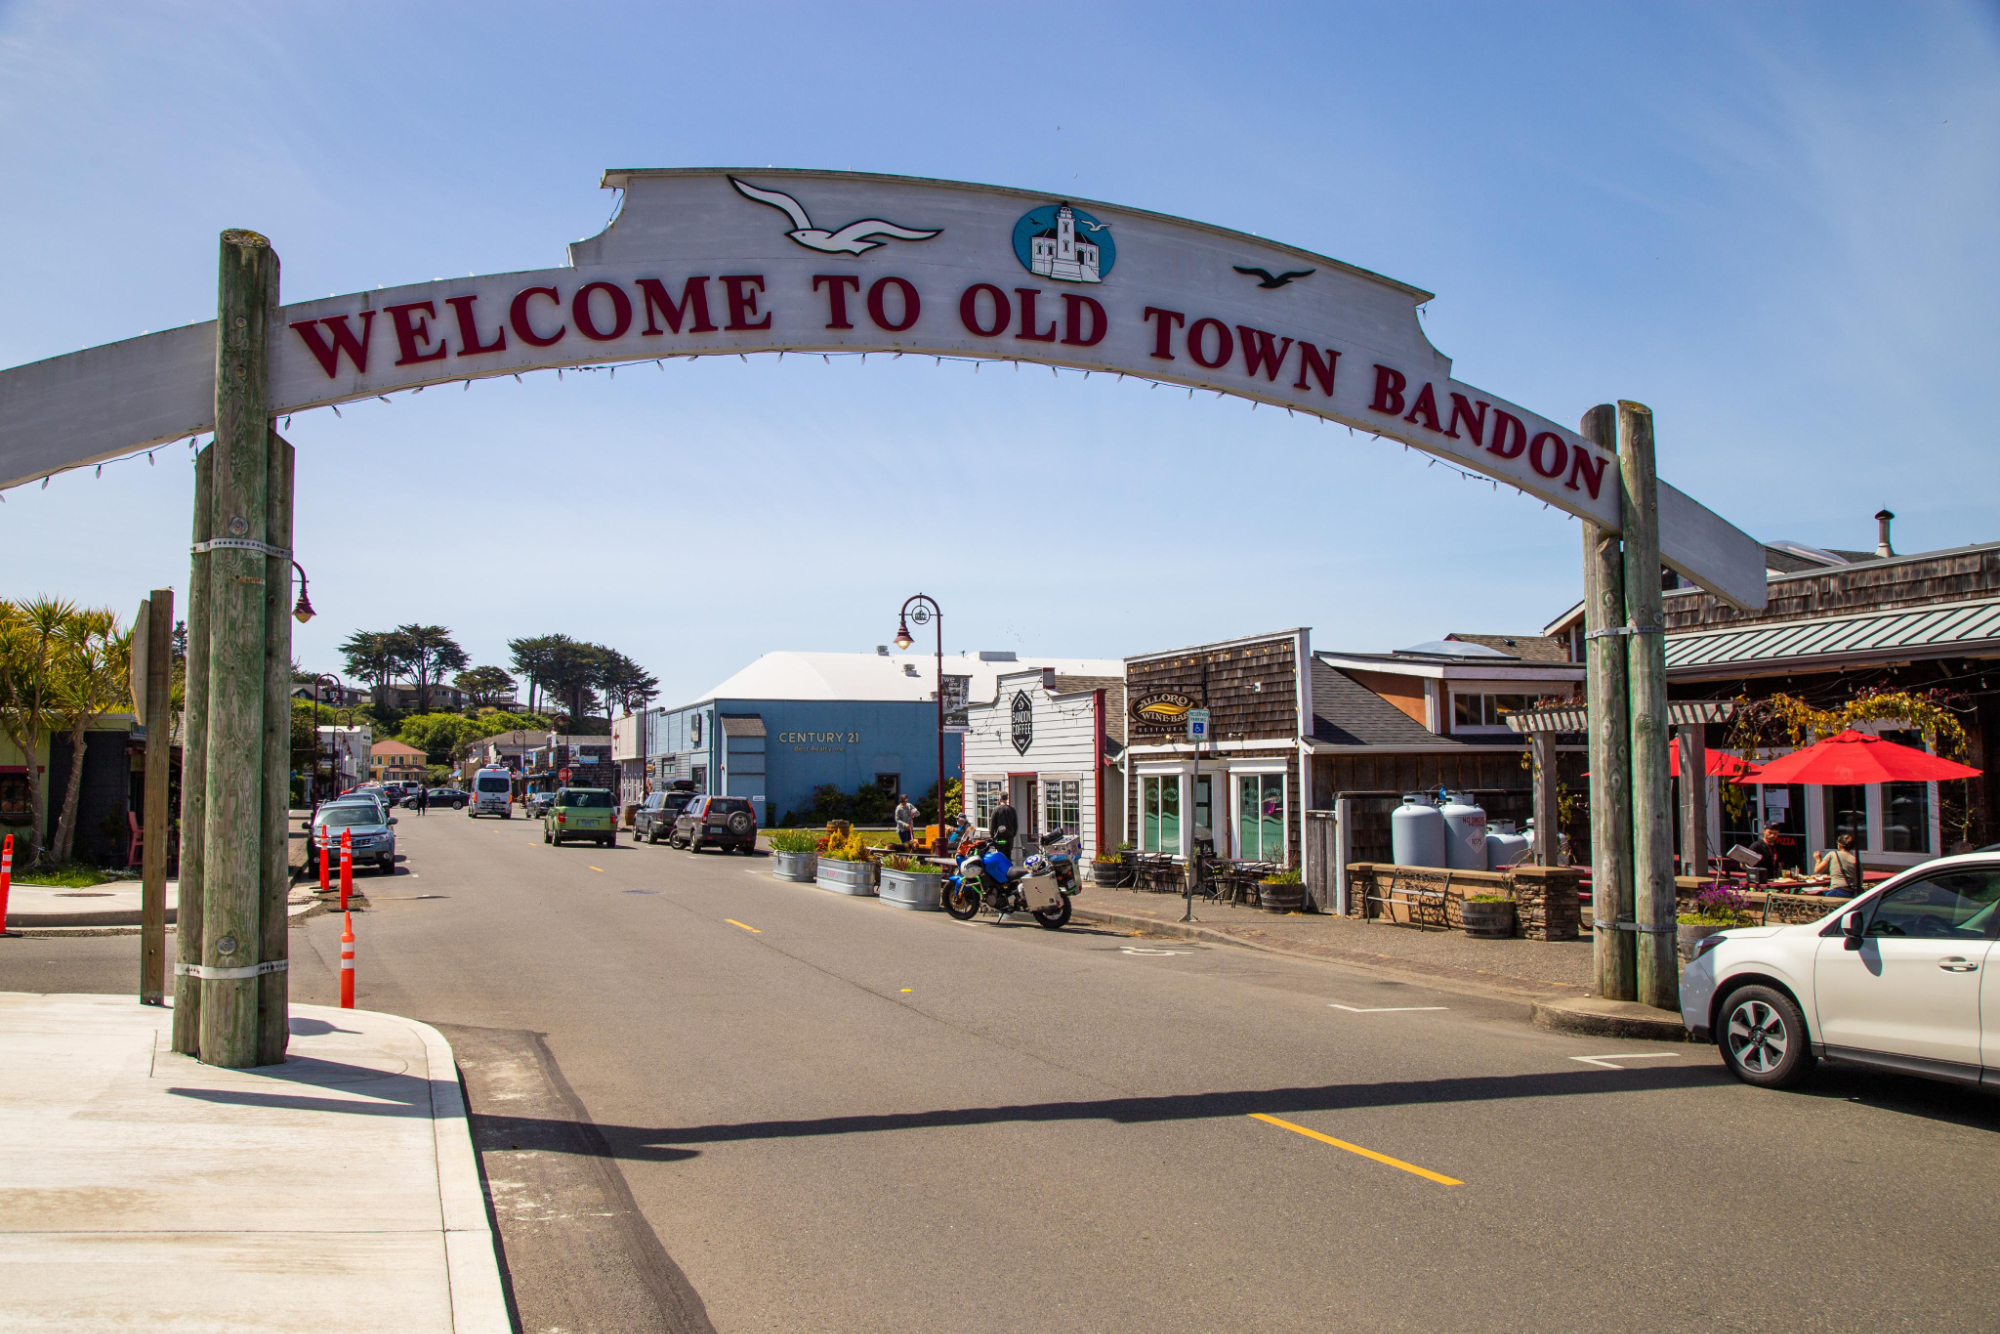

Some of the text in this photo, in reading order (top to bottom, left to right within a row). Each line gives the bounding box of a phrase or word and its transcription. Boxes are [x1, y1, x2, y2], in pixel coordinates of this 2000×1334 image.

[289, 274, 1610, 500] WELCOME TO OLD TOWN BANDON
[1136, 693, 1188, 709] ALLORO
[1012, 710, 1031, 723] BANDON
[1012, 723, 1031, 736] COFFEE
[778, 732, 859, 743] CENTURY 21
[1776, 837, 1796, 845] PIZZA
